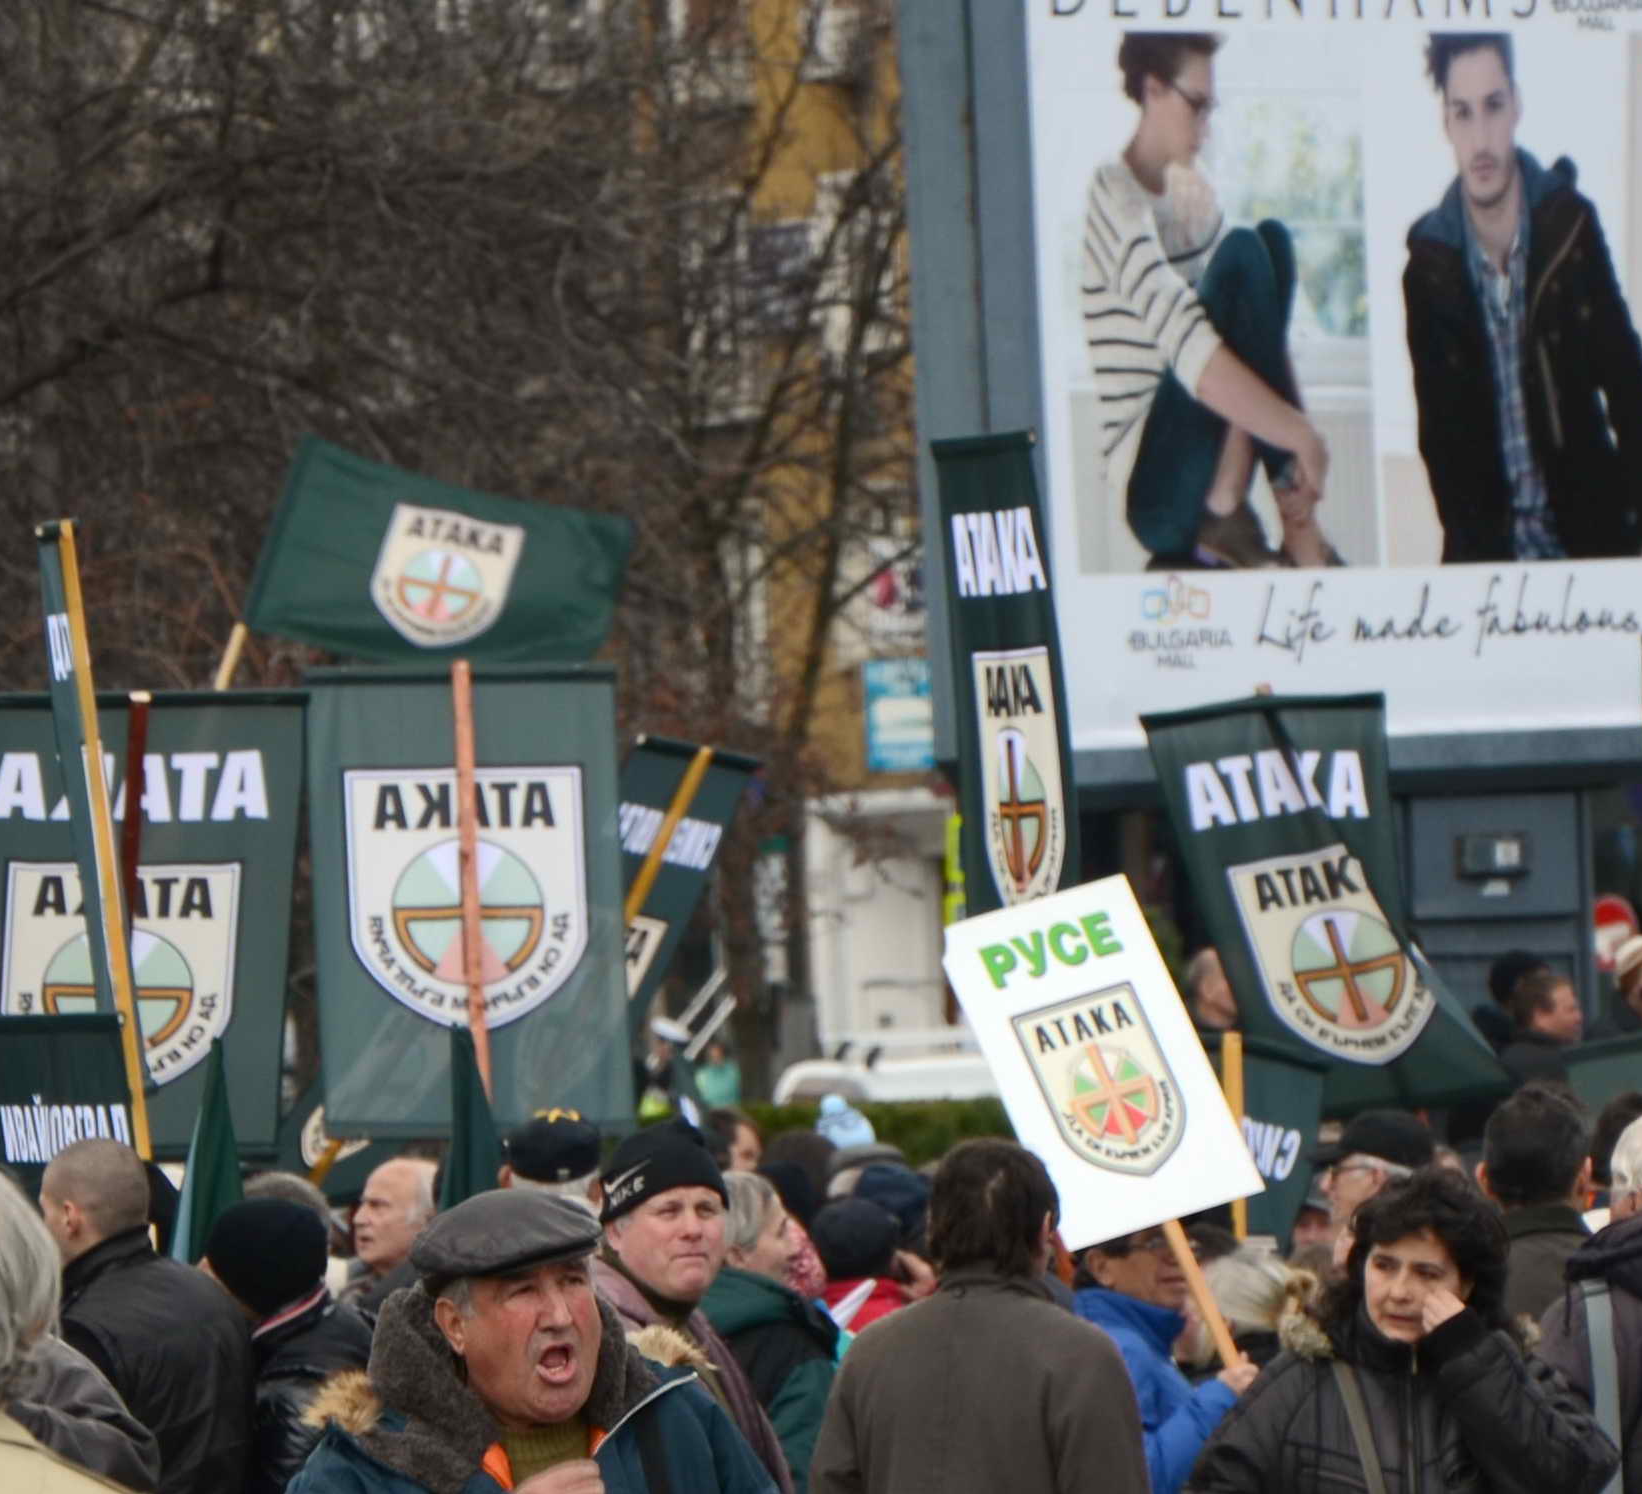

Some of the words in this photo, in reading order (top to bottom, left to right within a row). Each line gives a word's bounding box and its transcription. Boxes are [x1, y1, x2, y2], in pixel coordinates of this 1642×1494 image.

[406, 516, 504, 556] АТАКА
[951, 506, 1048, 597] АТАКА
[1254, 580, 1335, 664] Life
[1351, 582, 1459, 641] made
[1474, 572, 1640, 657] fabulous
[1186, 748, 1370, 833] АТАКА
[1254, 854, 1362, 912] АТАК
[979, 911, 1124, 989] РУСЕ
[1035, 1002, 1133, 1053] АТАКА
[610, 1175, 645, 1207] NIKE
